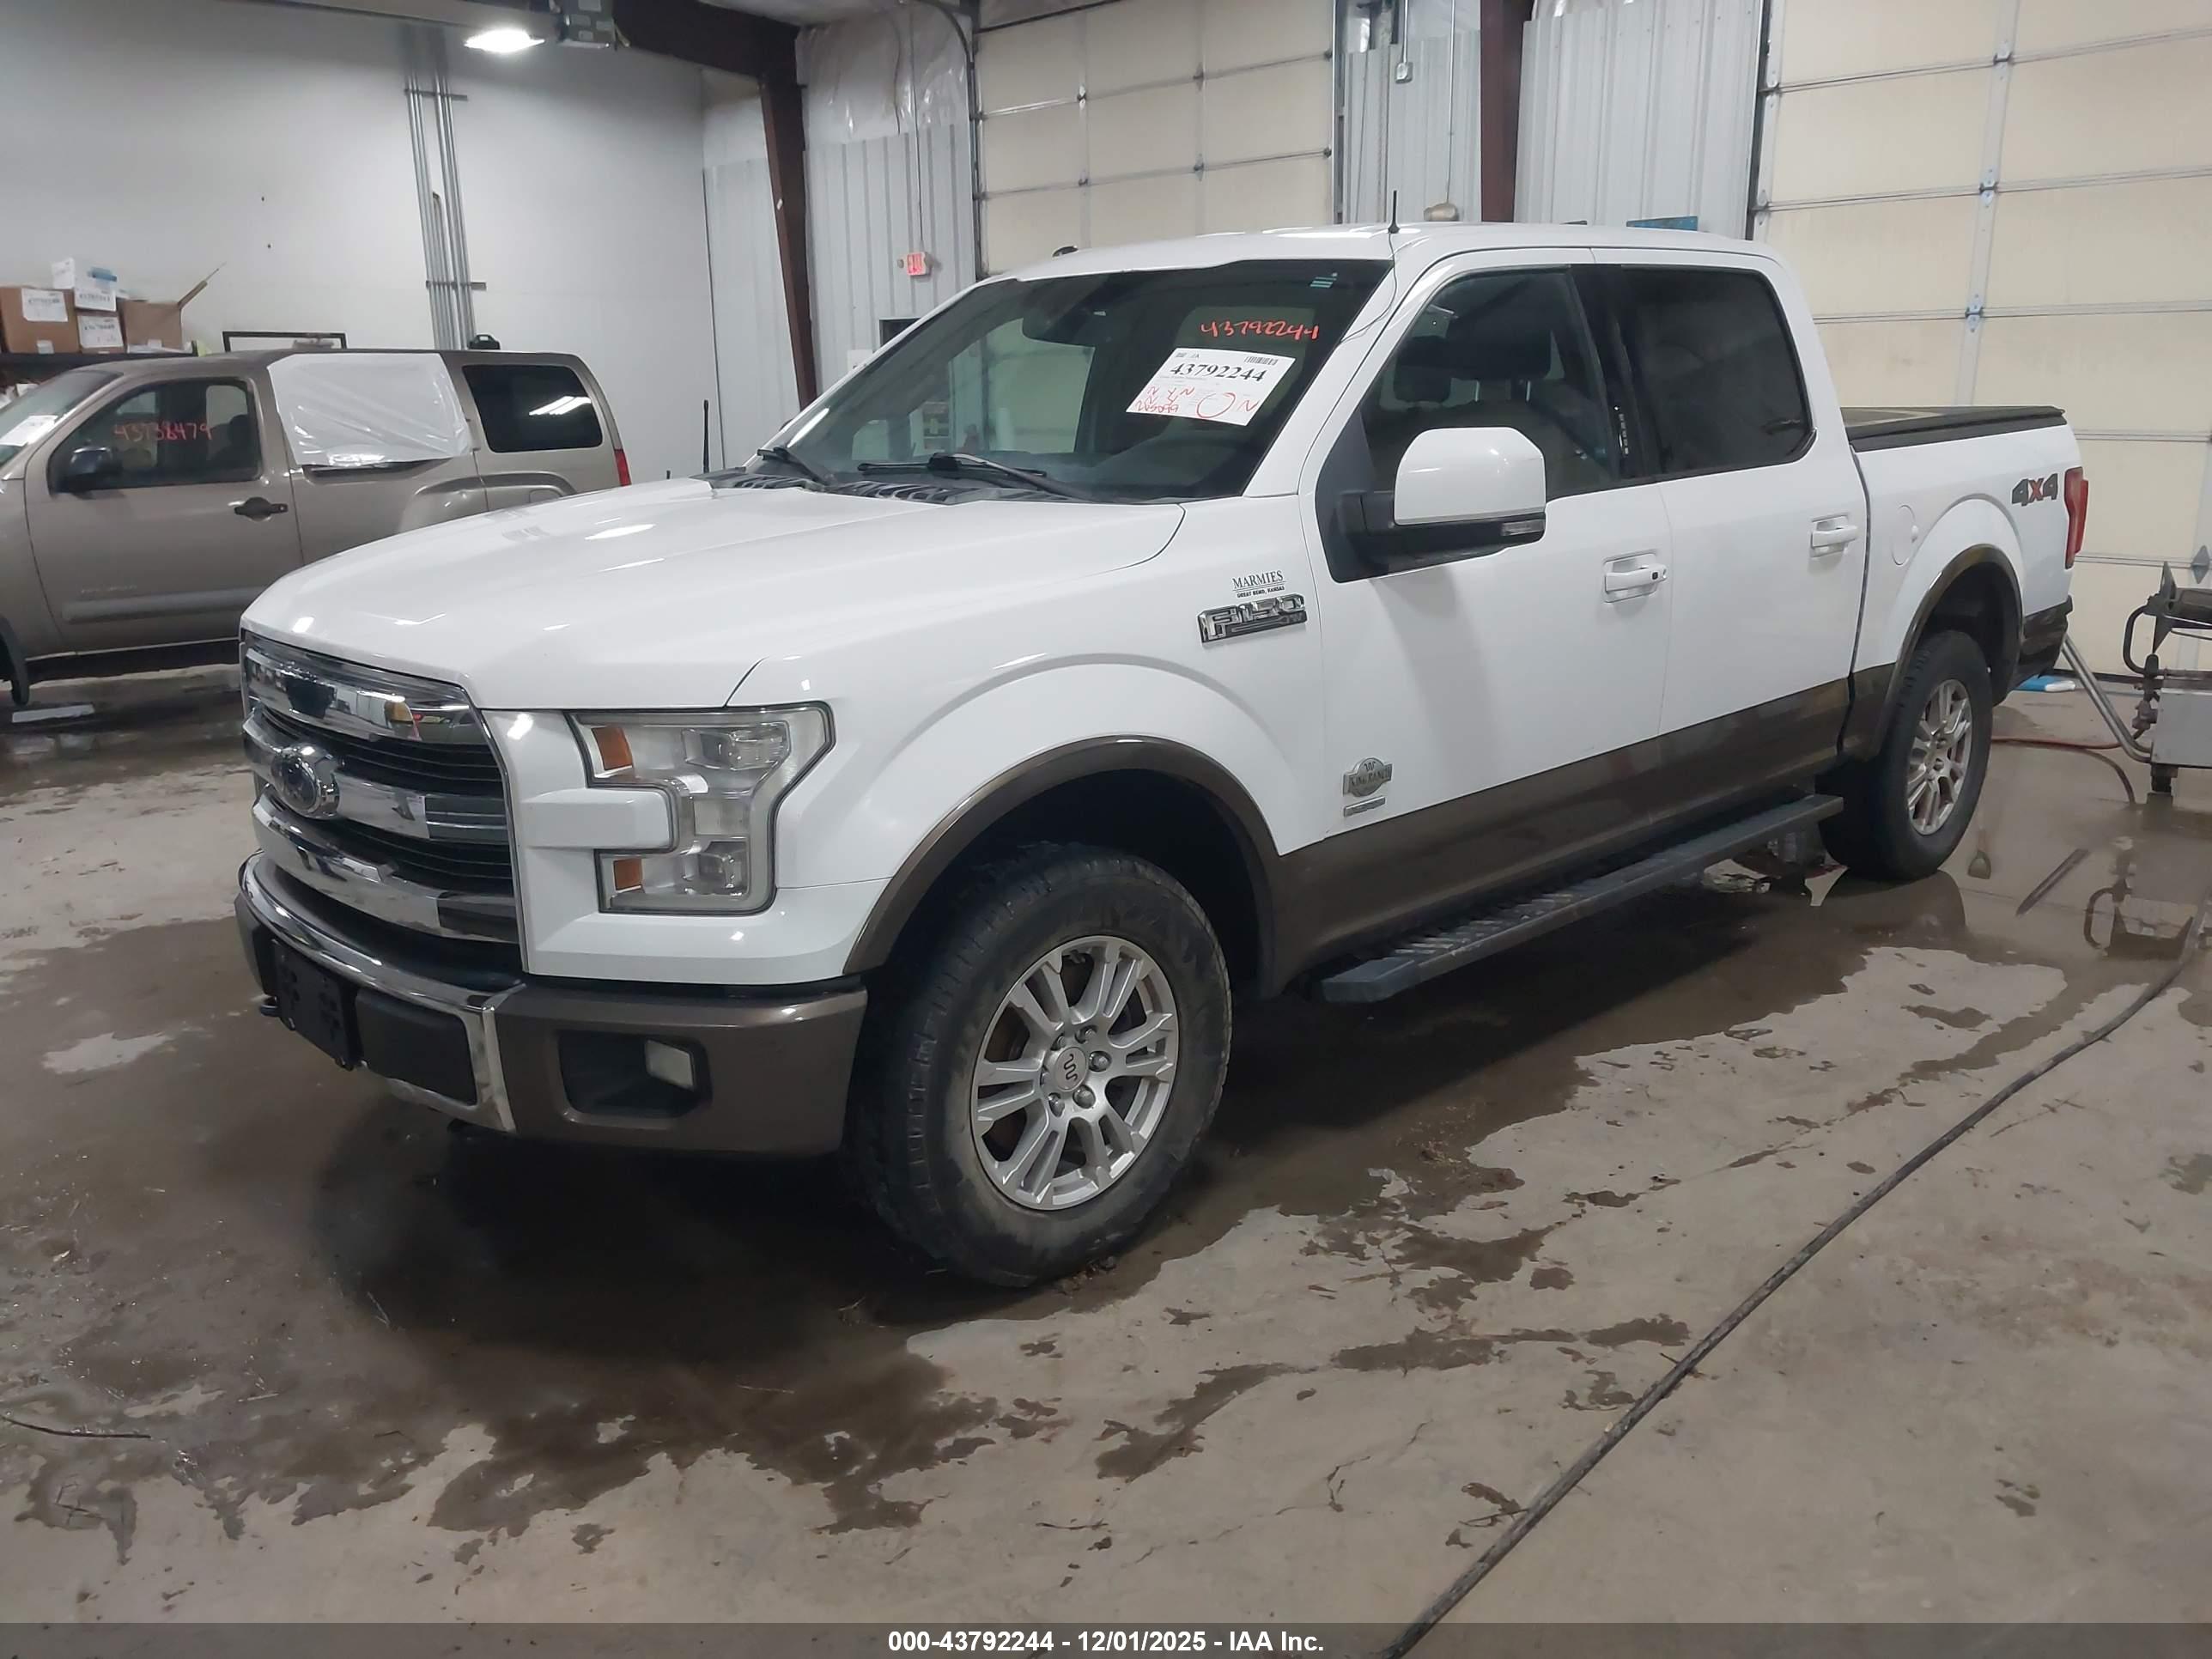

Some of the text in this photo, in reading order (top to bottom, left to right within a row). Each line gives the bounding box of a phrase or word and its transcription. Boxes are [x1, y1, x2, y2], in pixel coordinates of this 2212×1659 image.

[1200, 319, 1320, 341] 43792244
[1170, 362, 1268, 383] 43792244
[1231, 570, 1284, 589] MARMIES
